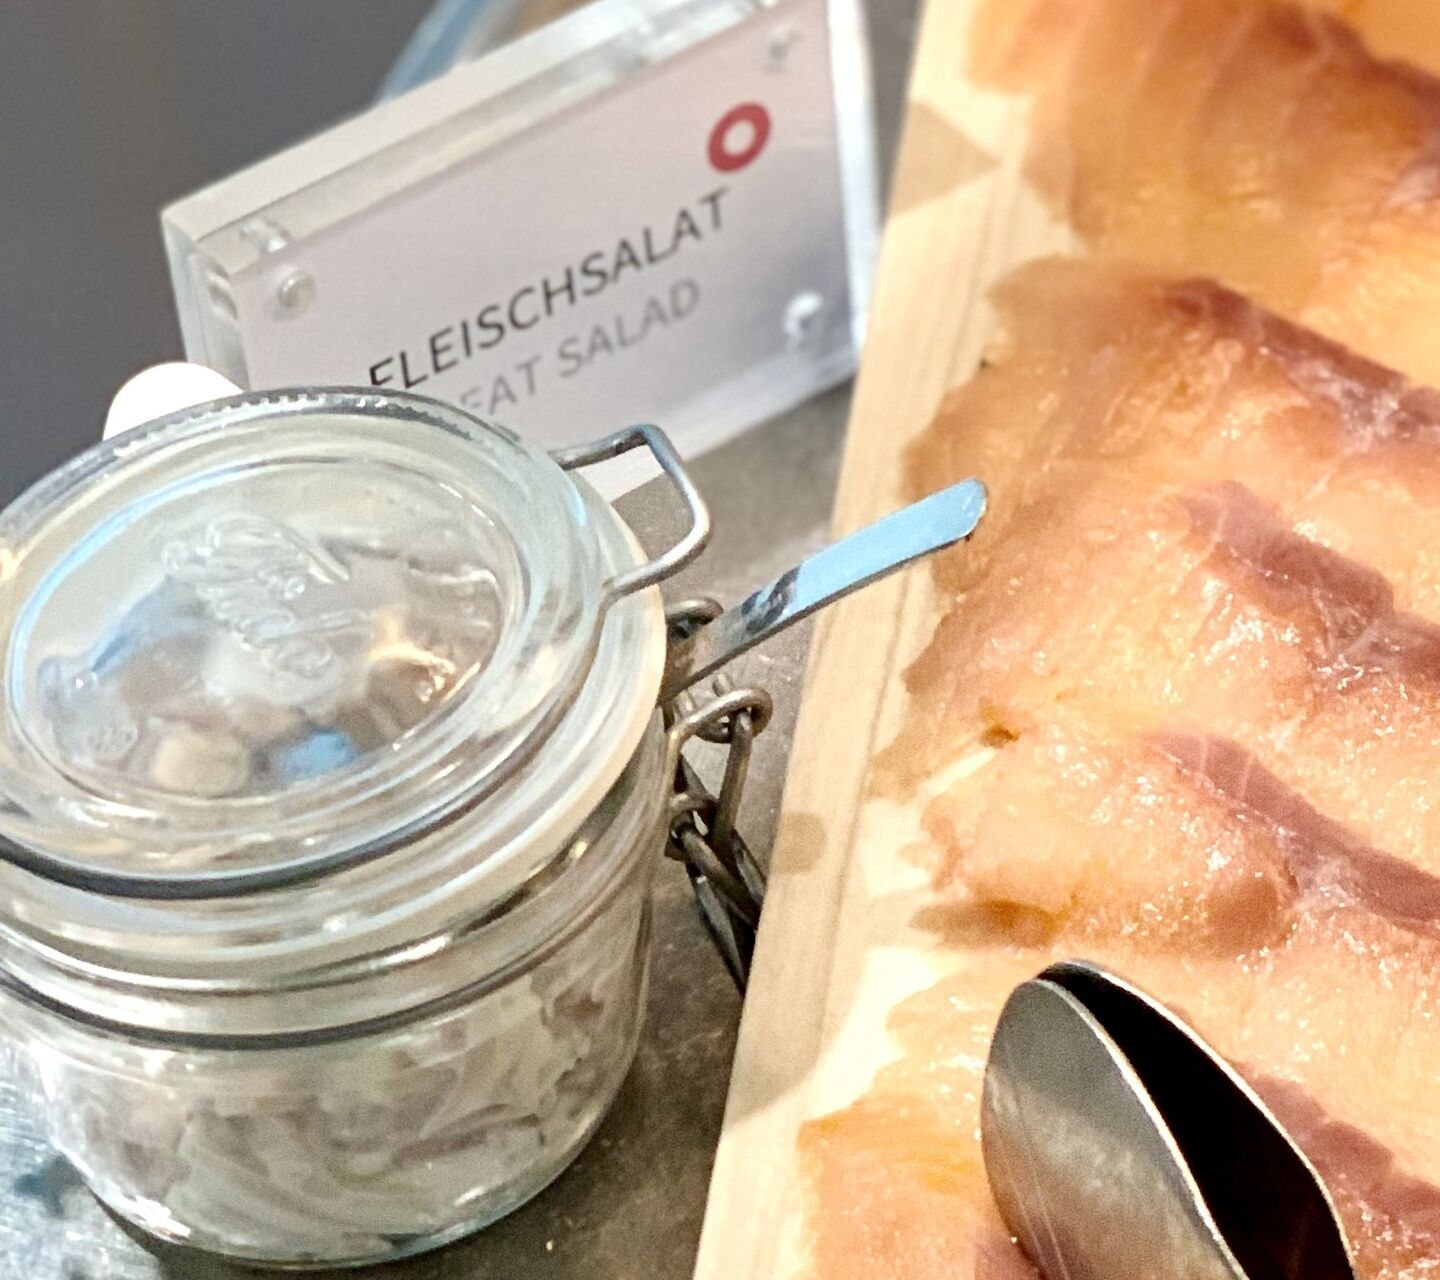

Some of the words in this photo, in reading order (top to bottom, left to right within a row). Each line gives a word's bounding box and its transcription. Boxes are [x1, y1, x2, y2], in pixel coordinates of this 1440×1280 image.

[369, 185, 731, 389] FLEISCHSALAT
[460, 356, 541, 415] EAT
[558, 278, 700, 378] SALAD
